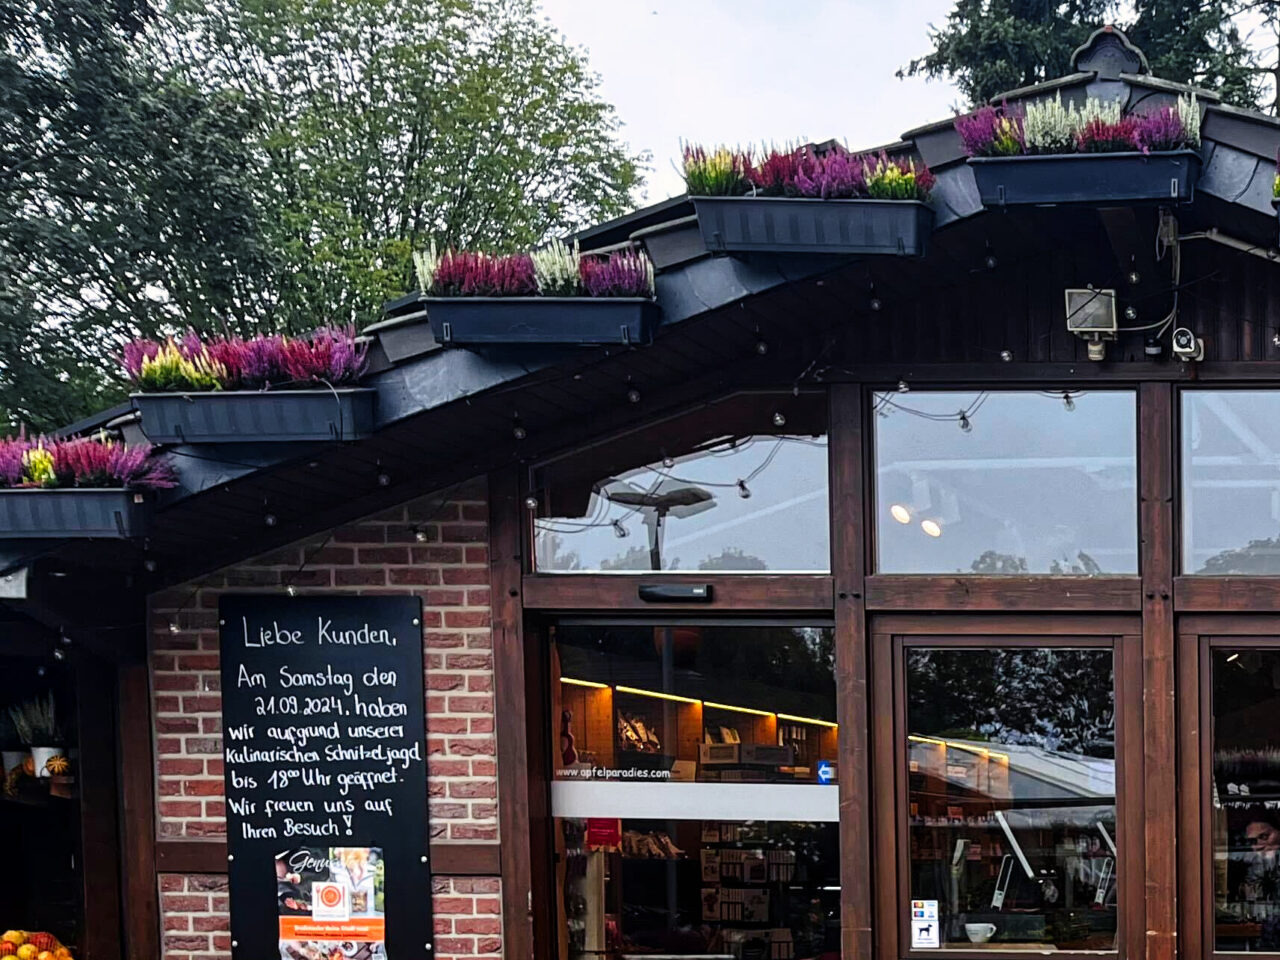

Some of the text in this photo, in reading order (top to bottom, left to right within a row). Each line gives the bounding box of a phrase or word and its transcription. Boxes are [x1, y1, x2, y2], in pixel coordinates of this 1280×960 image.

[243, 616, 396, 647] Liebe Kunden,
[238, 664, 396, 696] Am Samstag den
[354, 694, 407, 718] haben
[267, 721, 340, 746] aufgrund
[348, 725, 403, 738] unserer
[232, 770, 257, 789] bis
[302, 768, 331, 786] Uhr
[556, 767, 671, 779] www.apfelparadies.com
[229, 797, 393, 818] Wir freuen uns auf
[242, 822, 277, 839] Ihren
[284, 818, 339, 837] Besuch
